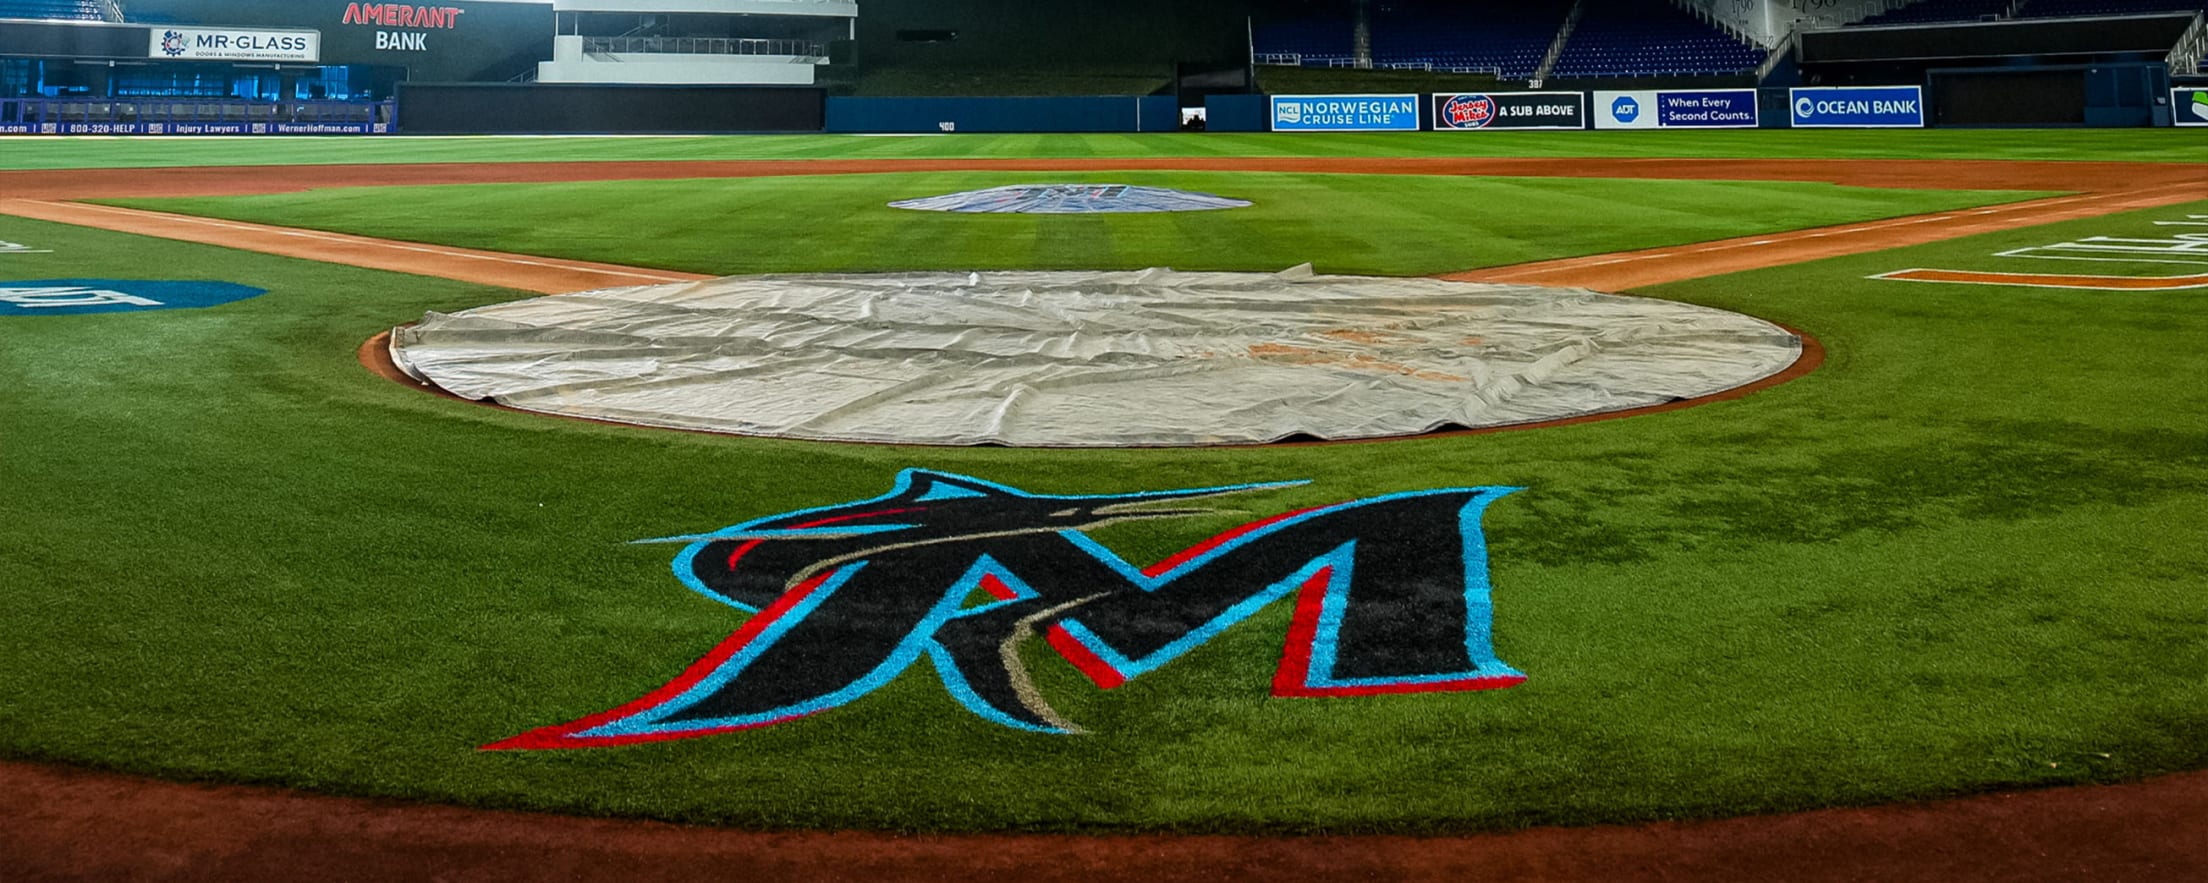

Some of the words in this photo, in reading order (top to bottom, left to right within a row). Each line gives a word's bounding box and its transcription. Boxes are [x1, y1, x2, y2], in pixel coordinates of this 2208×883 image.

[342, 2, 461, 29] AMERANT
[196, 34, 306, 51] MR-GLASS
[375, 31, 427, 51] BANK
[1303, 101, 1412, 115] NORWEGIAN
[1449, 99, 1488, 113] Jersey
[1668, 97, 1699, 108] When
[1702, 97, 1731, 109] Every
[1816, 100, 1869, 115] OCEAN
[1873, 99, 1917, 114] BANK
[1279, 106, 1299, 115] NCL
[1499, 107, 1508, 117] A
[1510, 106, 1533, 117] SUB
[1535, 105, 1574, 116] ABOVE
[1616, 104, 1635, 115] ADT
[1302, 114, 1353, 125] CRUISE
[1359, 114, 1391, 124] LINE
[1669, 110, 1708, 121] Second
[1710, 110, 1754, 121] Counts.
[70, 124, 135, 133] 800-320-HELP
[176, 123, 202, 134] Injury
[204, 123, 240, 134] Lawyers
[278, 123, 361, 133] WernerHoffman.com
[938, 121, 955, 131] 400
